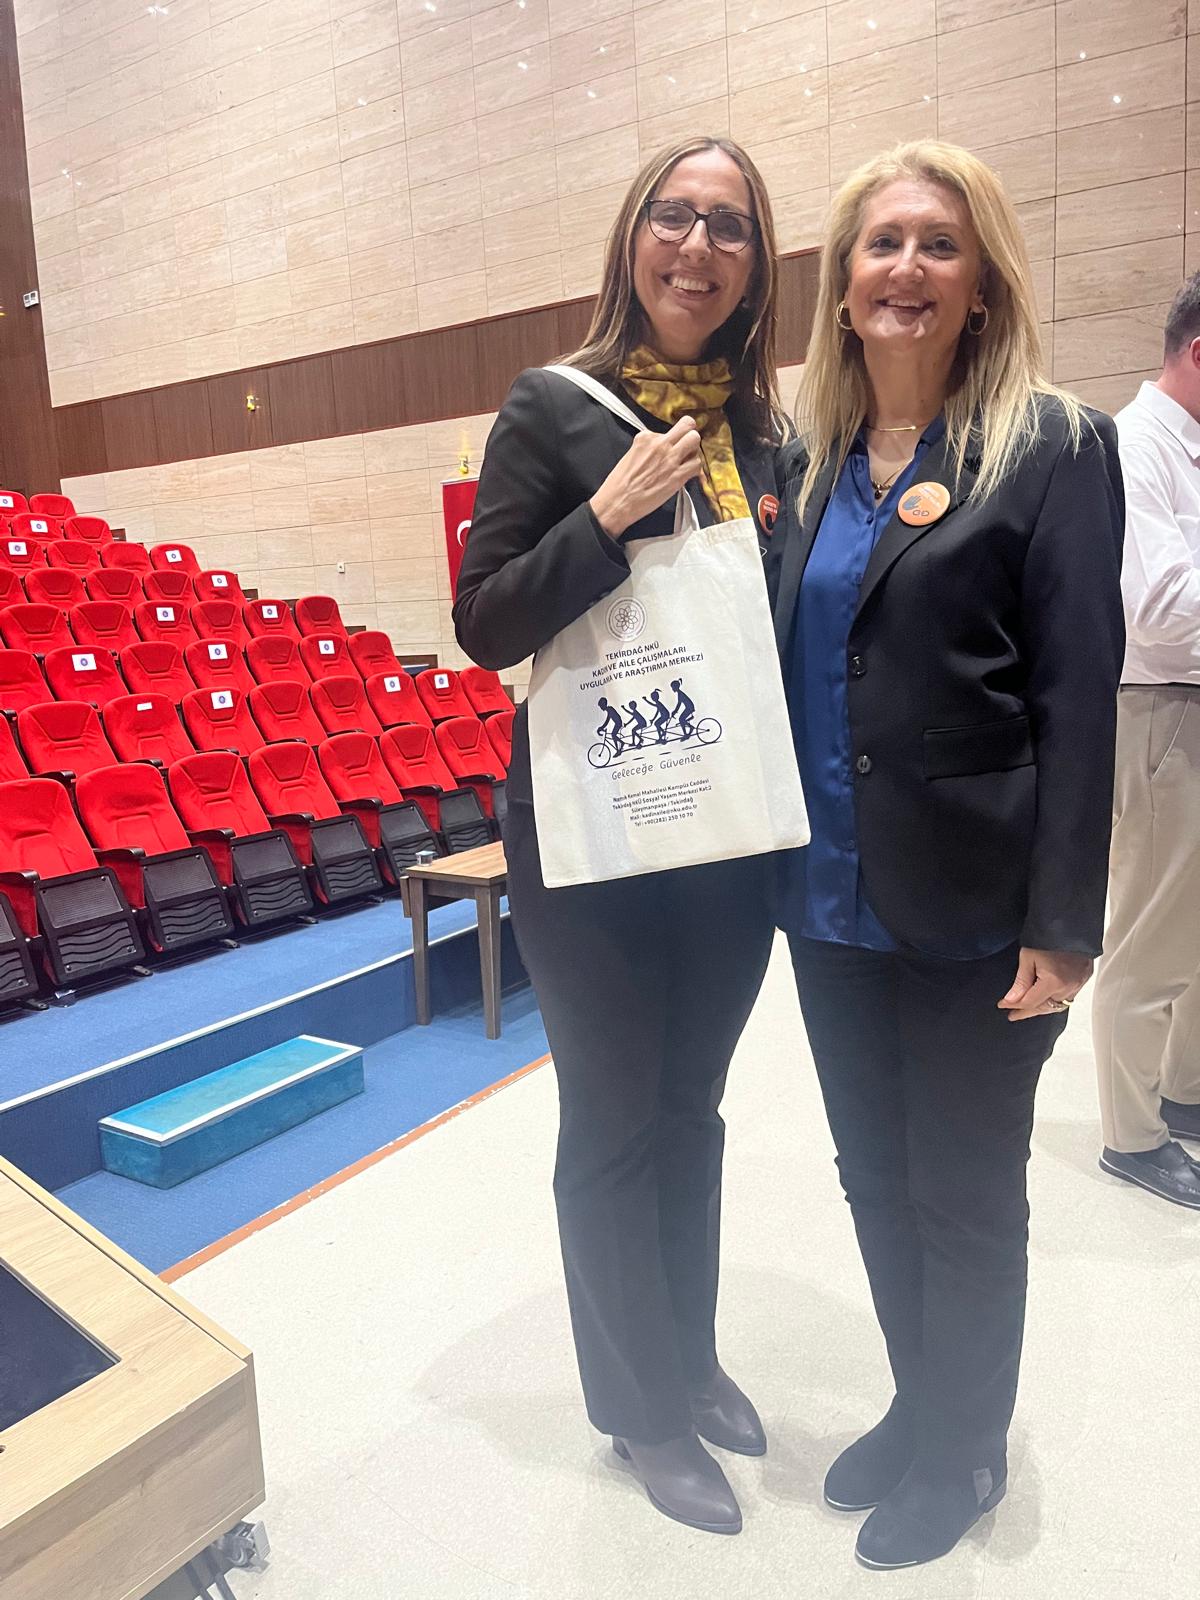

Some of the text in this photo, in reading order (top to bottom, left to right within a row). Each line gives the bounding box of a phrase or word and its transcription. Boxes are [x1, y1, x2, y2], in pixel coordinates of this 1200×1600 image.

[605, 641, 660, 661] TEKİRDAĞ NKÜ
[608, 662, 617, 671] VE
[618, 658, 636, 668] AİLE
[637, 646, 686, 666] ÇALIŞMALARI
[614, 672, 624, 680] VE
[624, 662, 668, 678] ARAŞTIRMA
[669, 652, 704, 666] MERKEZİ
[612, 753, 702, 780] Geleceğe Güvenle
